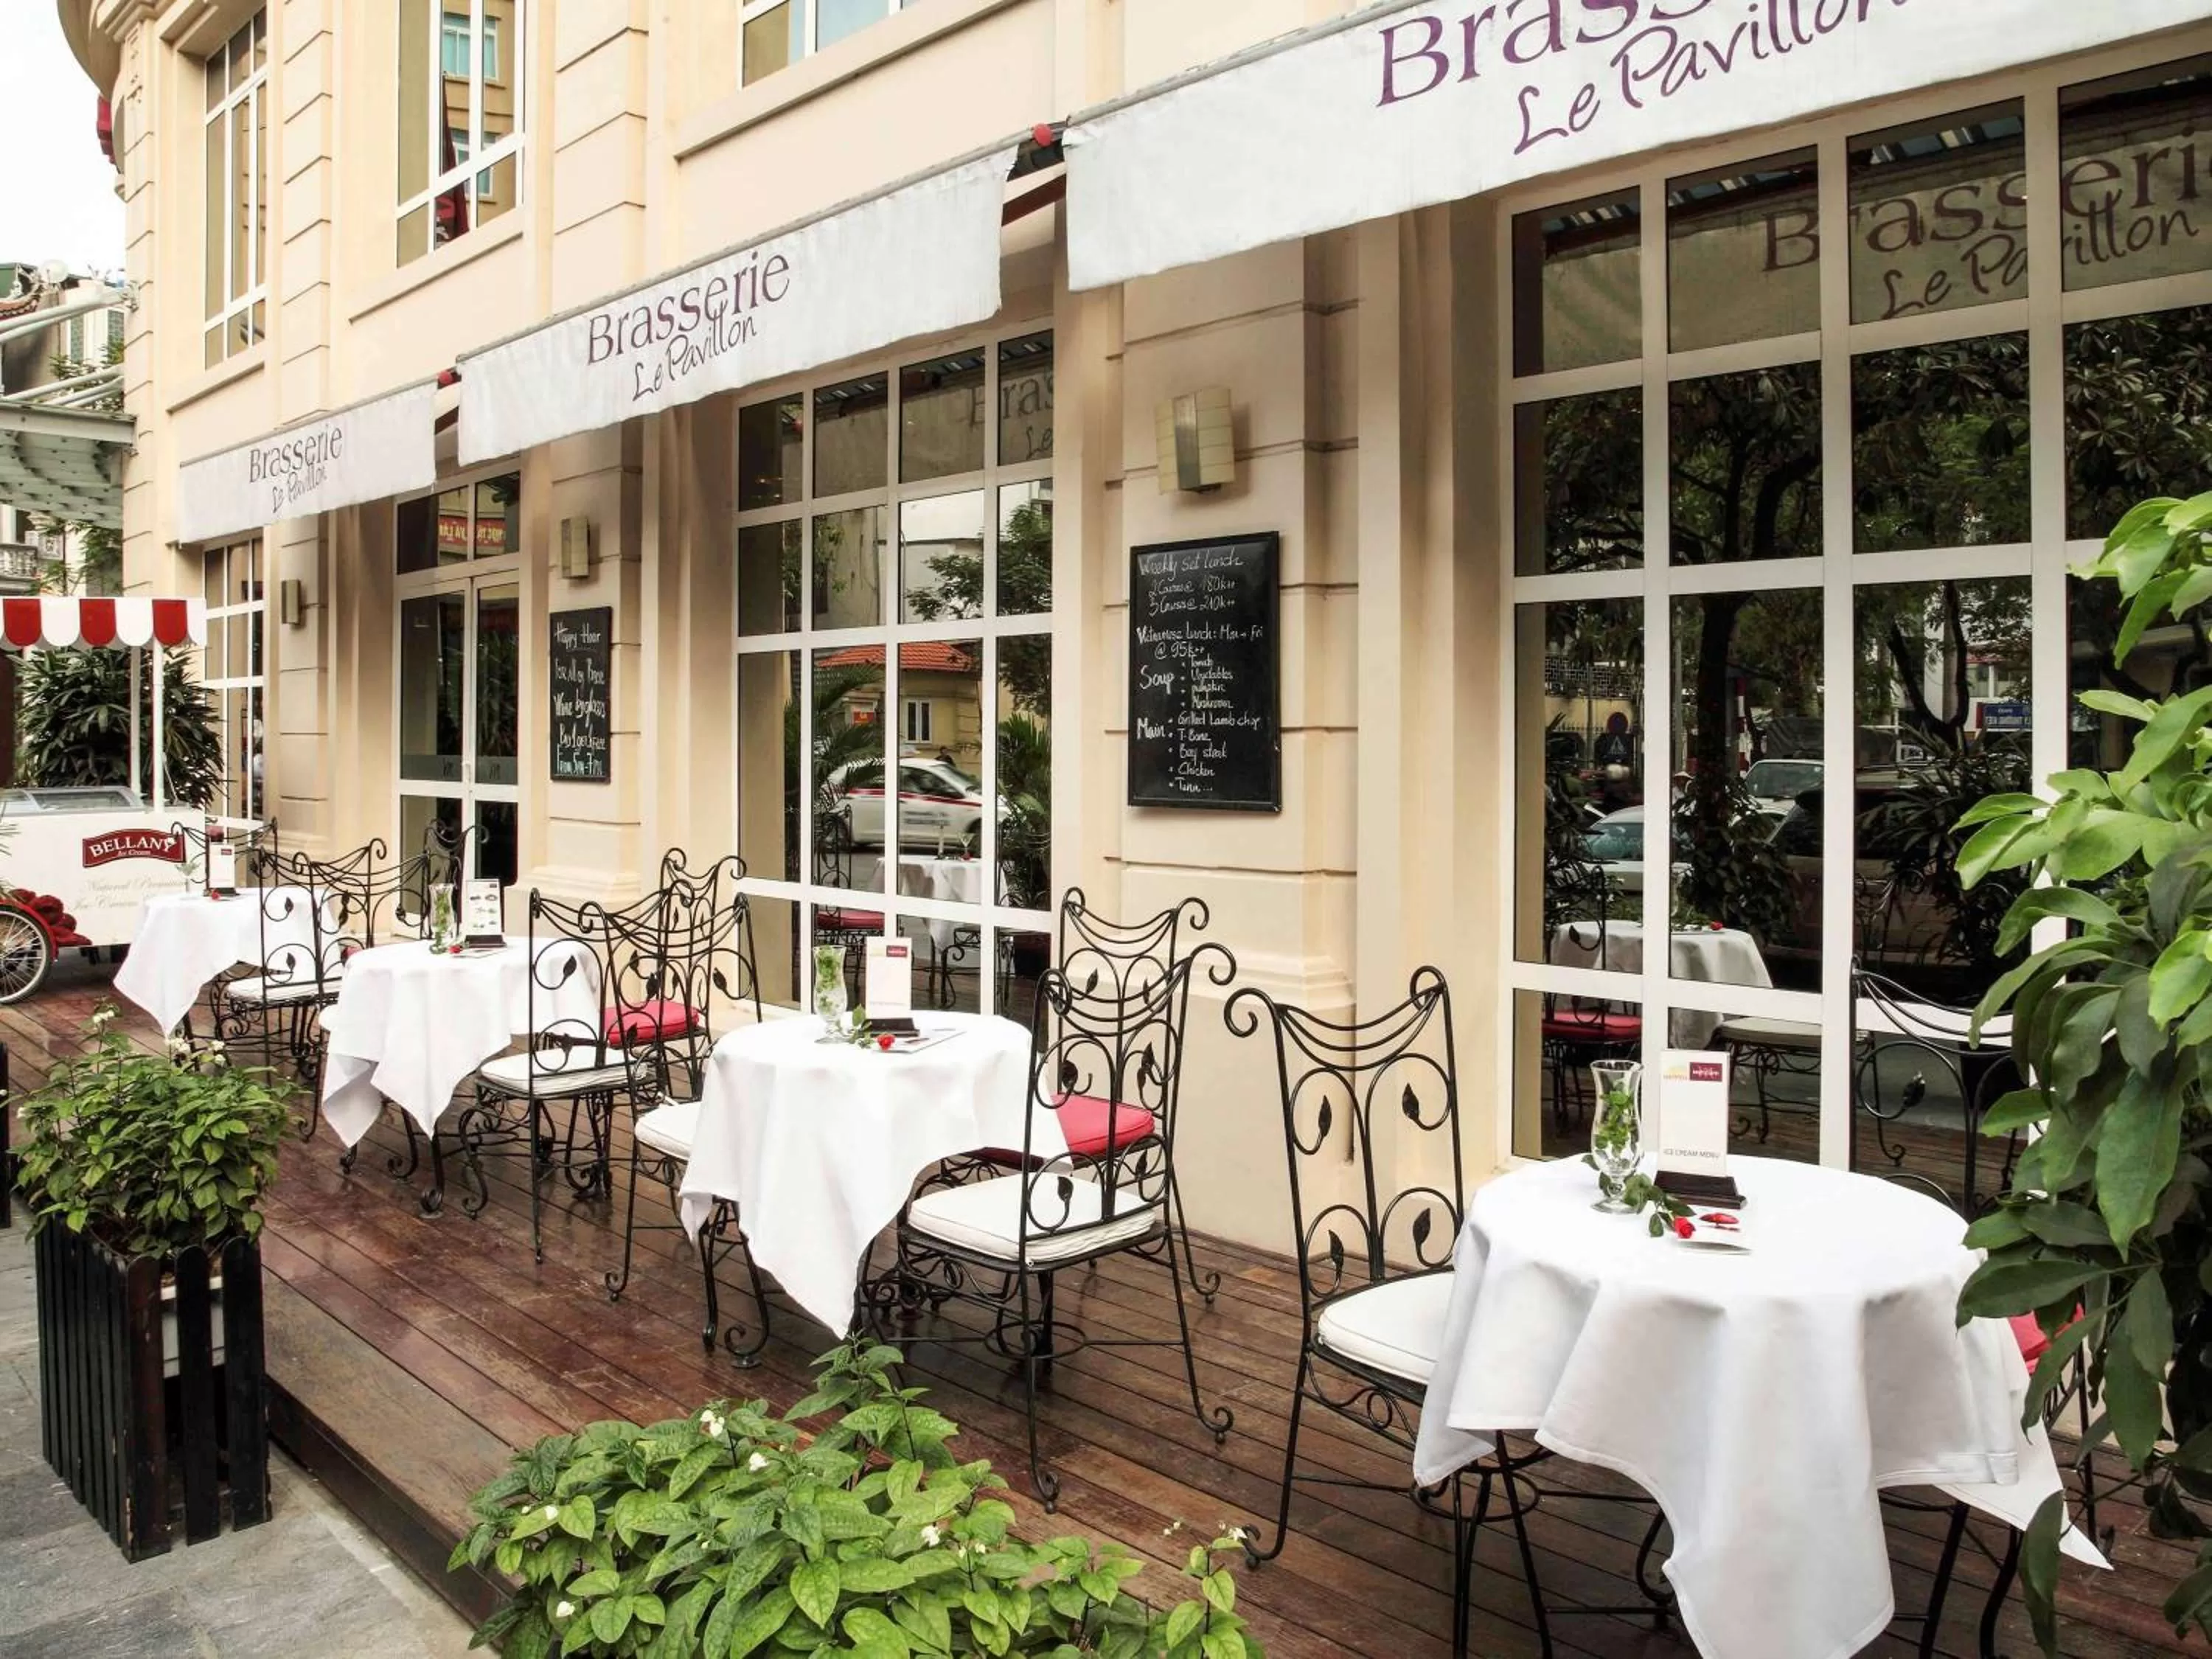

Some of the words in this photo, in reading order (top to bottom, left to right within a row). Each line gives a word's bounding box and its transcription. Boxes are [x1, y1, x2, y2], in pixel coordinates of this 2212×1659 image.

[1514, 83, 1600, 155] Le
[588, 251, 790, 366] Brasserie
[1882, 269, 1950, 320] Le
[633, 362, 662, 402] Le
[666, 299, 757, 382] Pavillon
[250, 424, 342, 484] Brasserie
[1139, 664, 1175, 695] Soup
[1137, 717, 1166, 740] Main
[89, 836, 176, 858] BELLANY
